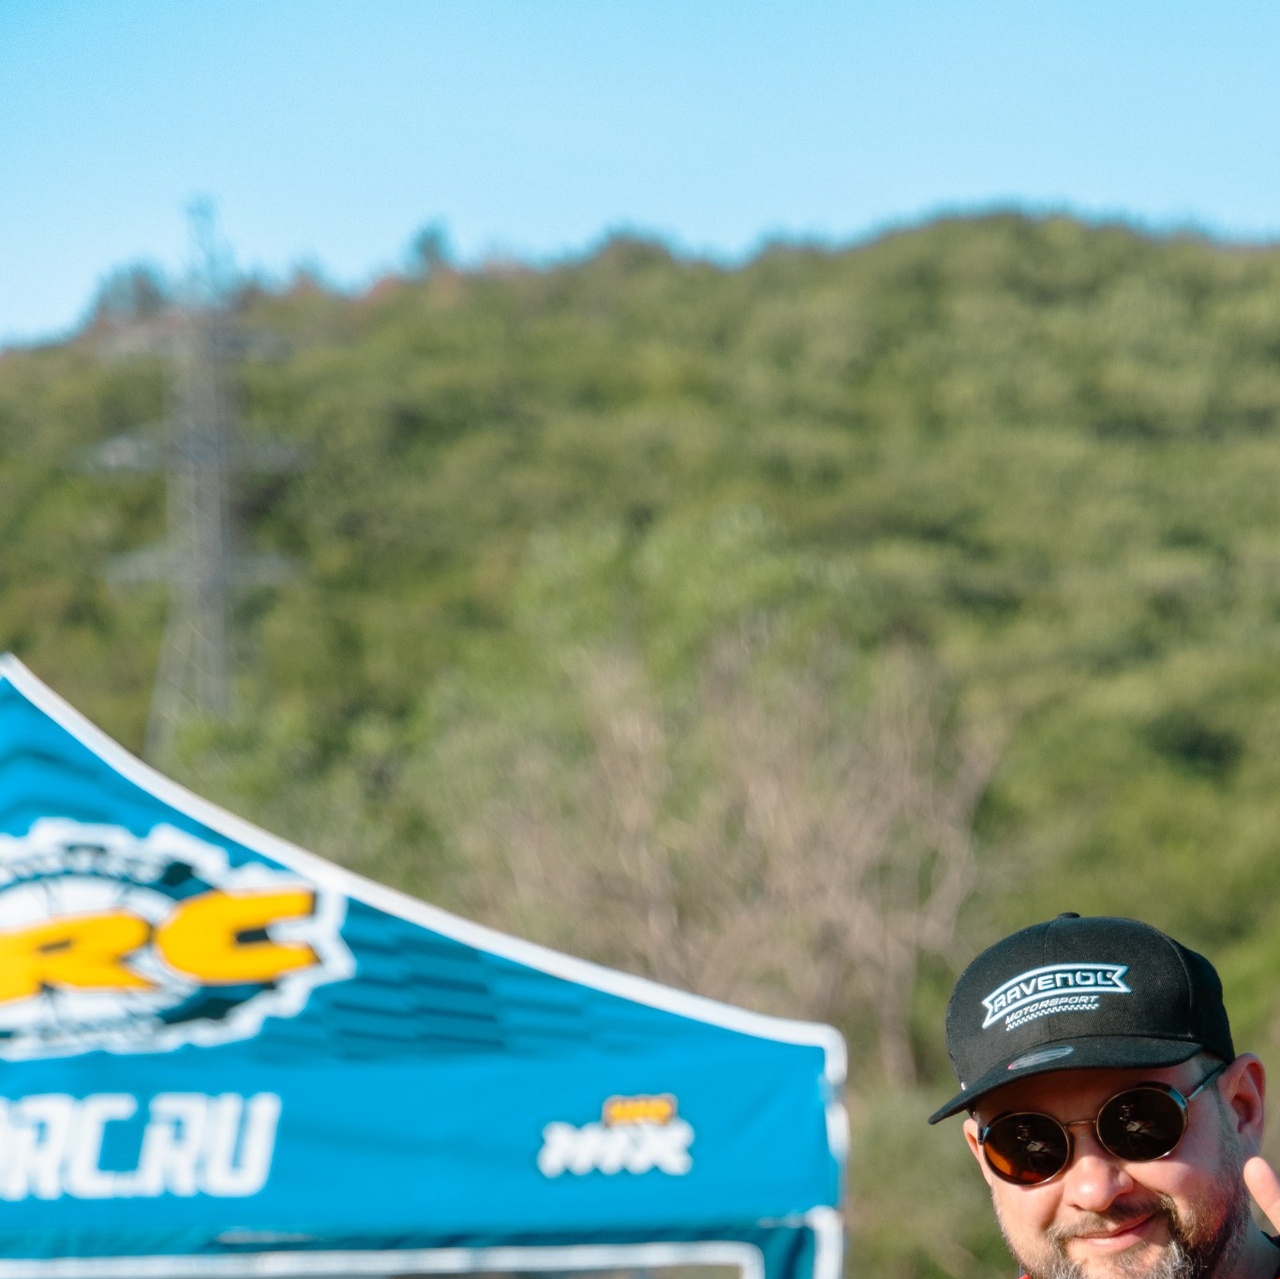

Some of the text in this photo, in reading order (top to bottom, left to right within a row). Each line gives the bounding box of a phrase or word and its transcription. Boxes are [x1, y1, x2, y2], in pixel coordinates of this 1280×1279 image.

[993, 971, 1112, 1012] RAVENOL
[1005, 995, 1099, 1024] MOTORSPORT
[0, 1092, 282, 1200] RC.RU
